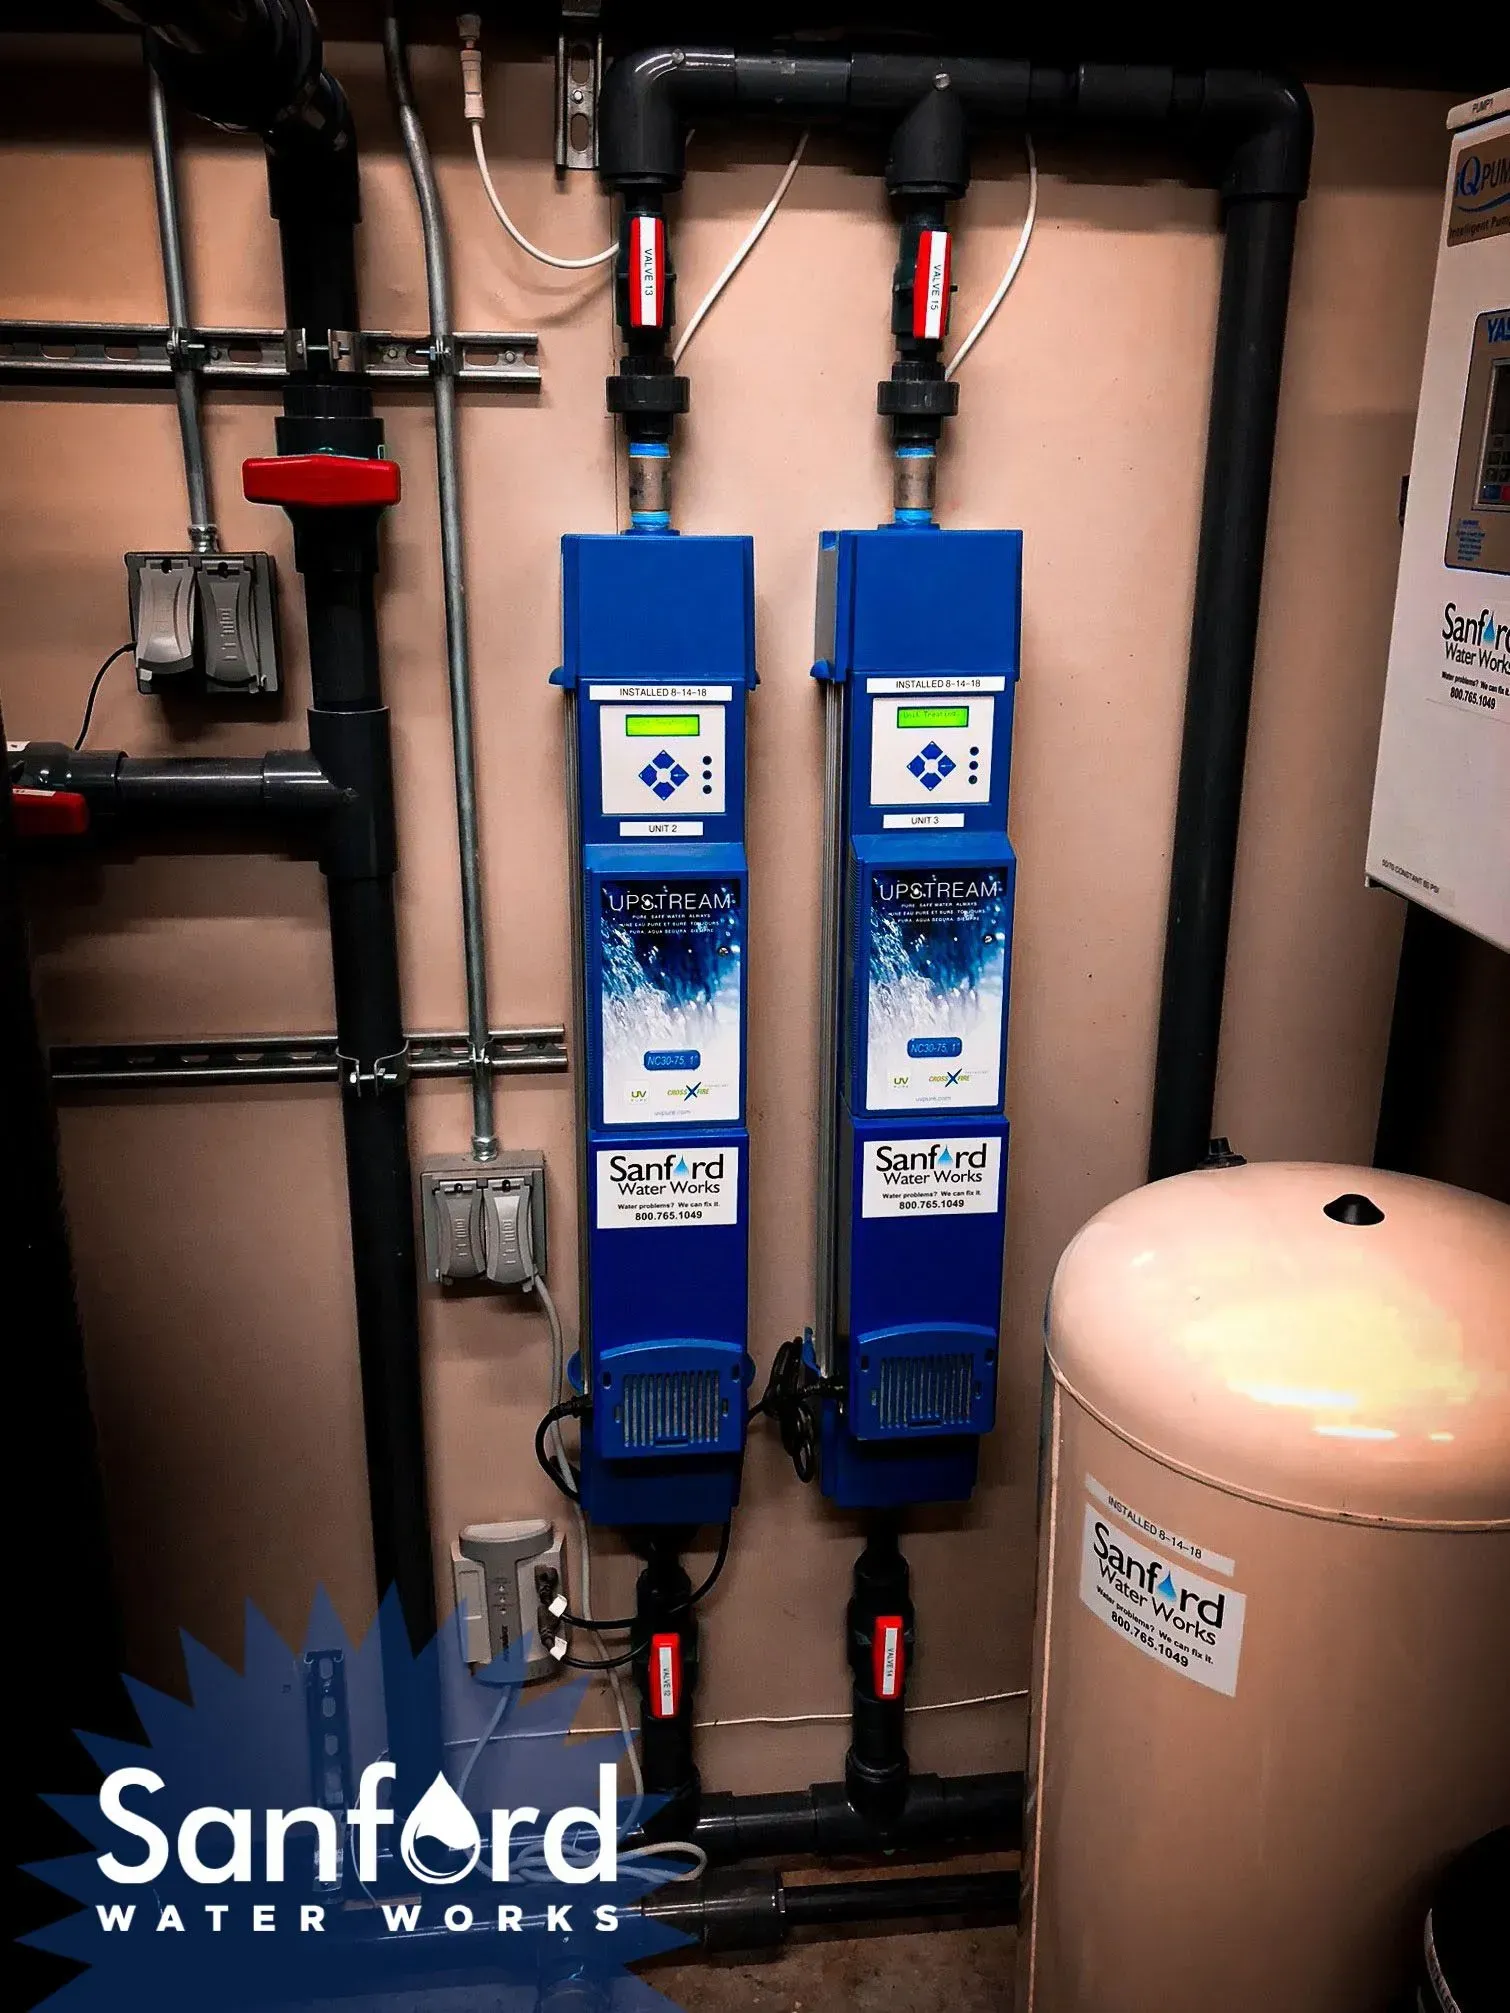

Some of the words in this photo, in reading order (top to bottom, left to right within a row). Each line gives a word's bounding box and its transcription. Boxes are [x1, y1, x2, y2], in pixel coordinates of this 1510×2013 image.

[644, 248, 653, 281] VALVE
[931, 264, 942, 296] VALVE
[645, 286, 654, 296] 13
[930, 300, 938, 310] 15
[1445, 641, 1476, 666] Water
[896, 680, 944, 688] INSTALLED
[1442, 671, 1454, 681] Water
[1454, 676, 1479, 687] problems?
[1480, 680, 1488, 690] We
[1488, 684, 1497, 692] can
[620, 688, 668, 697] INSTALLED
[670, 688, 707, 697] 8-14-18
[1450, 686, 1496, 709] 800.765.1049
[648, 824, 669, 832] UNIT
[912, 817, 932, 825] UNIT
[934, 816, 940, 824] 3
[880, 882, 997, 900] UPSTREAM
[610, 893, 731, 912] UPSTREAM
[894, 1077, 909, 1085] UV
[632, 1090, 647, 1098] UV
[876, 1143, 986, 1172] Sanford
[610, 1153, 724, 1182] Sanford
[884, 1172, 930, 1185] Water
[934, 1170, 982, 1183] Works
[618, 1182, 666, 1196] Water
[670, 1180, 720, 1194] Works
[903, 1192, 938, 1200] problems?
[640, 1202, 674, 1212] problems?
[899, 1200, 965, 1210] 800.765.1049
[636, 1211, 702, 1220] 800.765.1049
[1108, 1495, 1157, 1535] INSTALLED
[1158, 1530, 1202, 1559] 8-14-18
[1094, 1522, 1225, 1629] Sanford
[1099, 1558, 1148, 1607] Water
[1150, 1597, 1216, 1646] Works
[1096, 1585, 1115, 1605] Water
[1116, 1602, 1155, 1633] problems?
[1159, 1630, 1172, 1644] We
[1174, 1640, 1190, 1653] can
[1192, 1648, 1203, 1660] fix
[1205, 1654, 1214, 1664] it.
[1111, 1611, 1189, 1668] 800.765.1049
